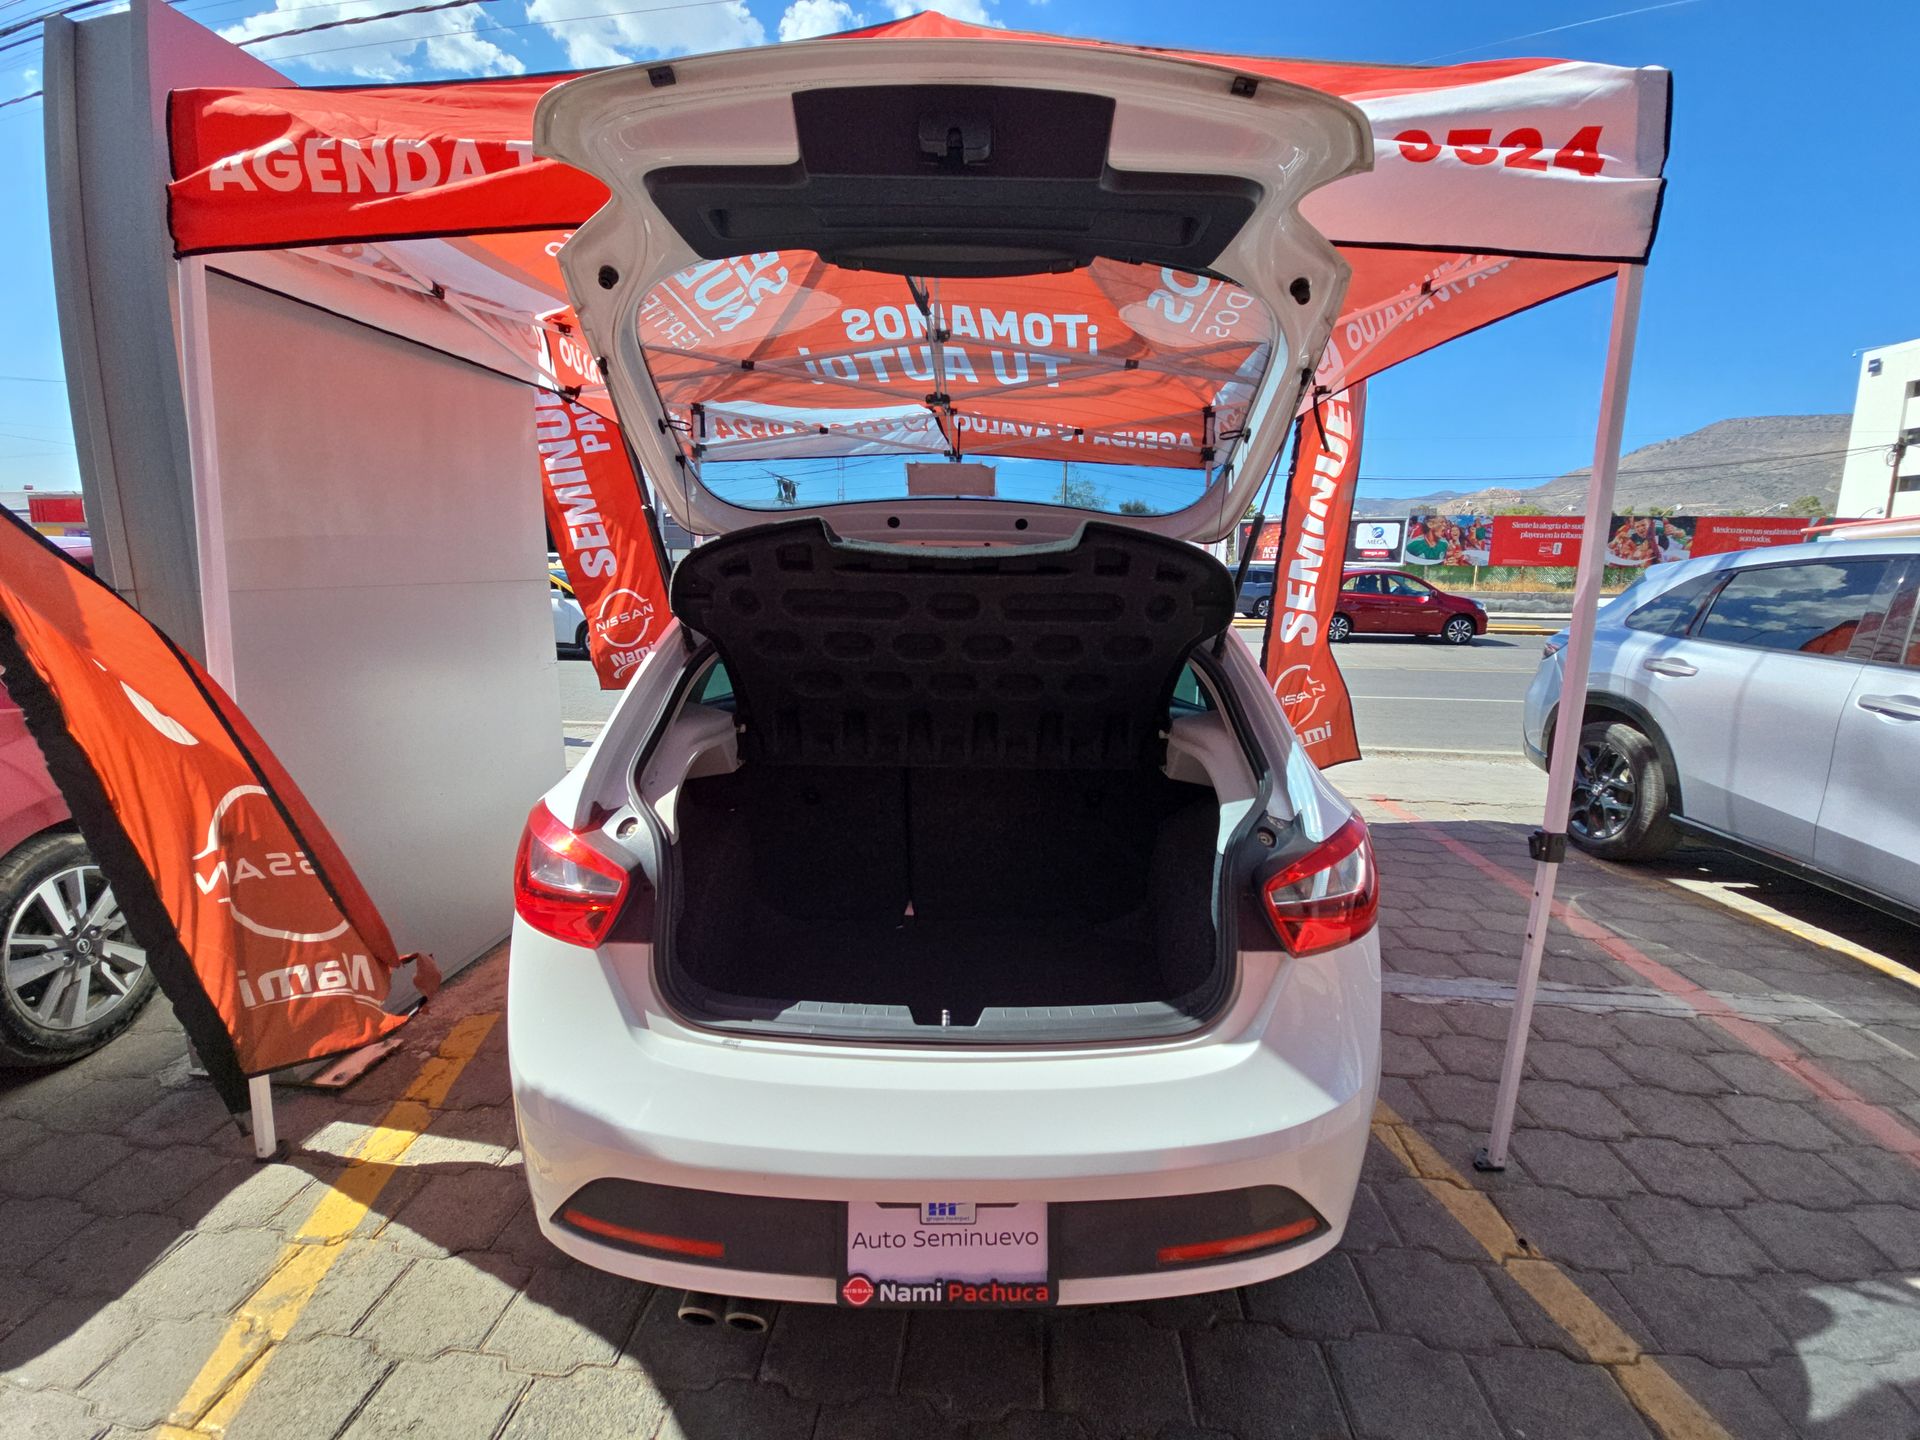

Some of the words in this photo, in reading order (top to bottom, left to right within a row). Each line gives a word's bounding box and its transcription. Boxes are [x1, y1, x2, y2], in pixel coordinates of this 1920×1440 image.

[209, 138, 486, 194] AGENDA
[1280, 389, 1352, 646] SEMINUE
[596, 603, 654, 633] NISSAN
[851, 1231, 907, 1250] Auto
[913, 1229, 1039, 1248] Seminuevo
[879, 1283, 942, 1302] Nami
[949, 1282, 1049, 1302] Pachuca
